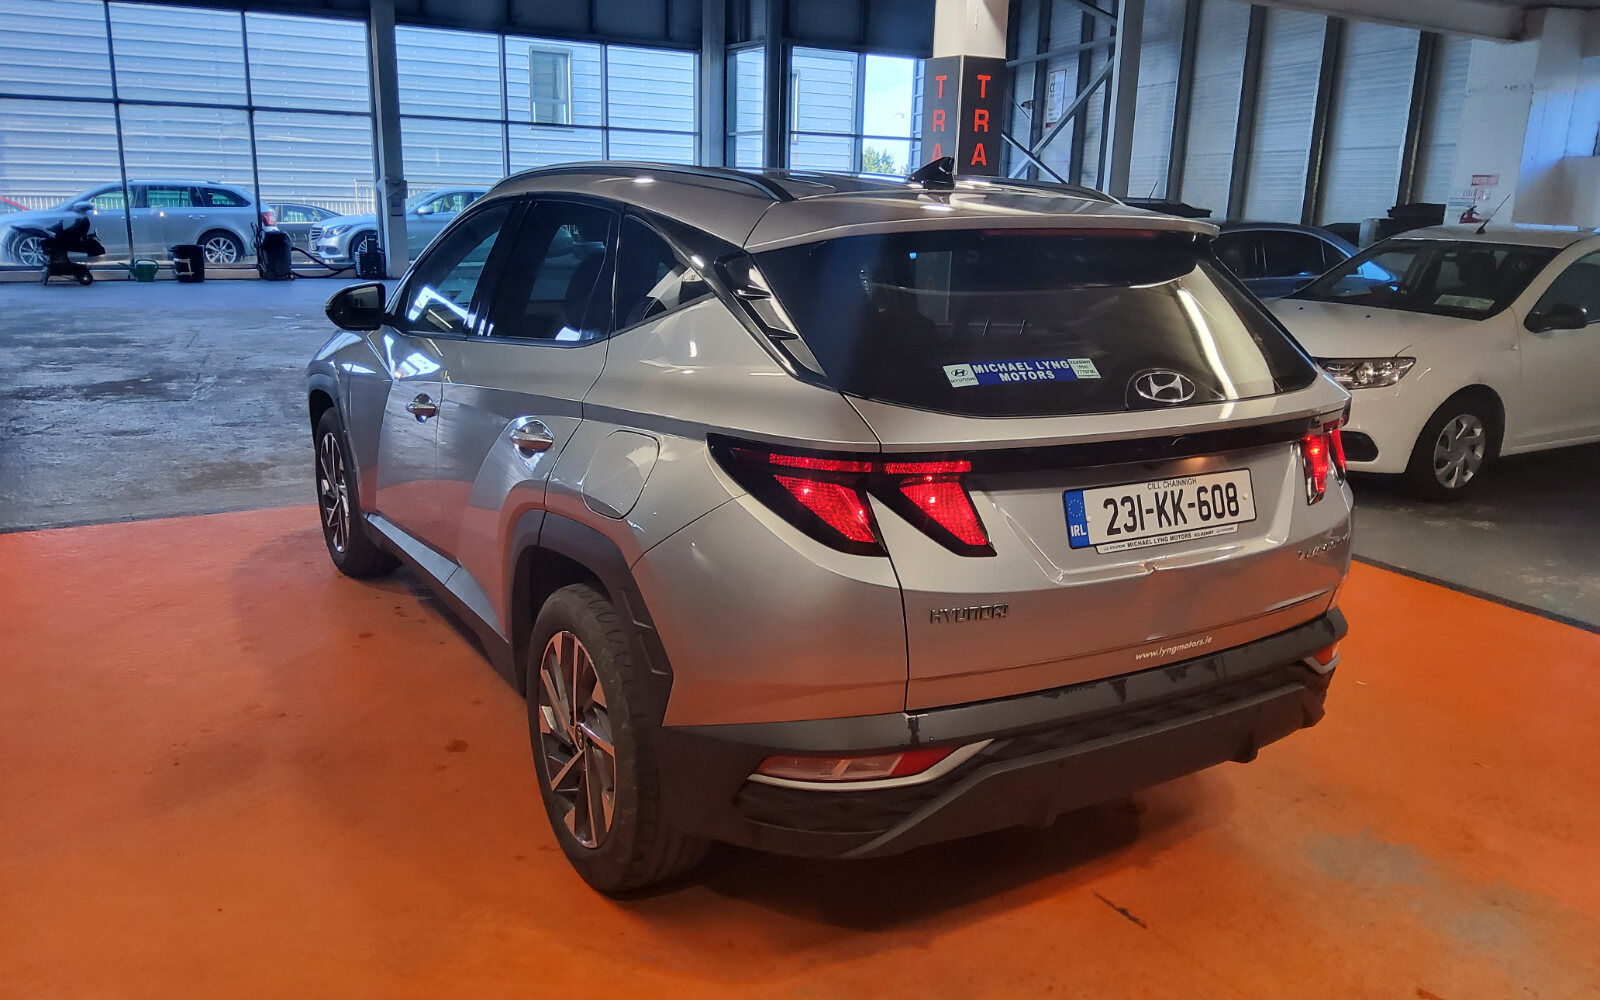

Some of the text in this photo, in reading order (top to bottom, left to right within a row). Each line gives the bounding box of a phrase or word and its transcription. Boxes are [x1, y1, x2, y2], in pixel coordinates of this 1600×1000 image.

[971, 362, 1033, 374] MICHAEL
[1035, 360, 1070, 370] LYNG
[999, 370, 1055, 382] MOTORS
[1147, 477, 1197, 490] CILL CHAINNIGH
[1070, 524, 1087, 538] IRL
[1127, 539, 1153, 548] MICHAEL
[1169, 532, 1192, 541] MOTORS
[930, 603, 1009, 624] HYUNDAI
[1135, 635, 1213, 660] www.lyngmotors.ie
